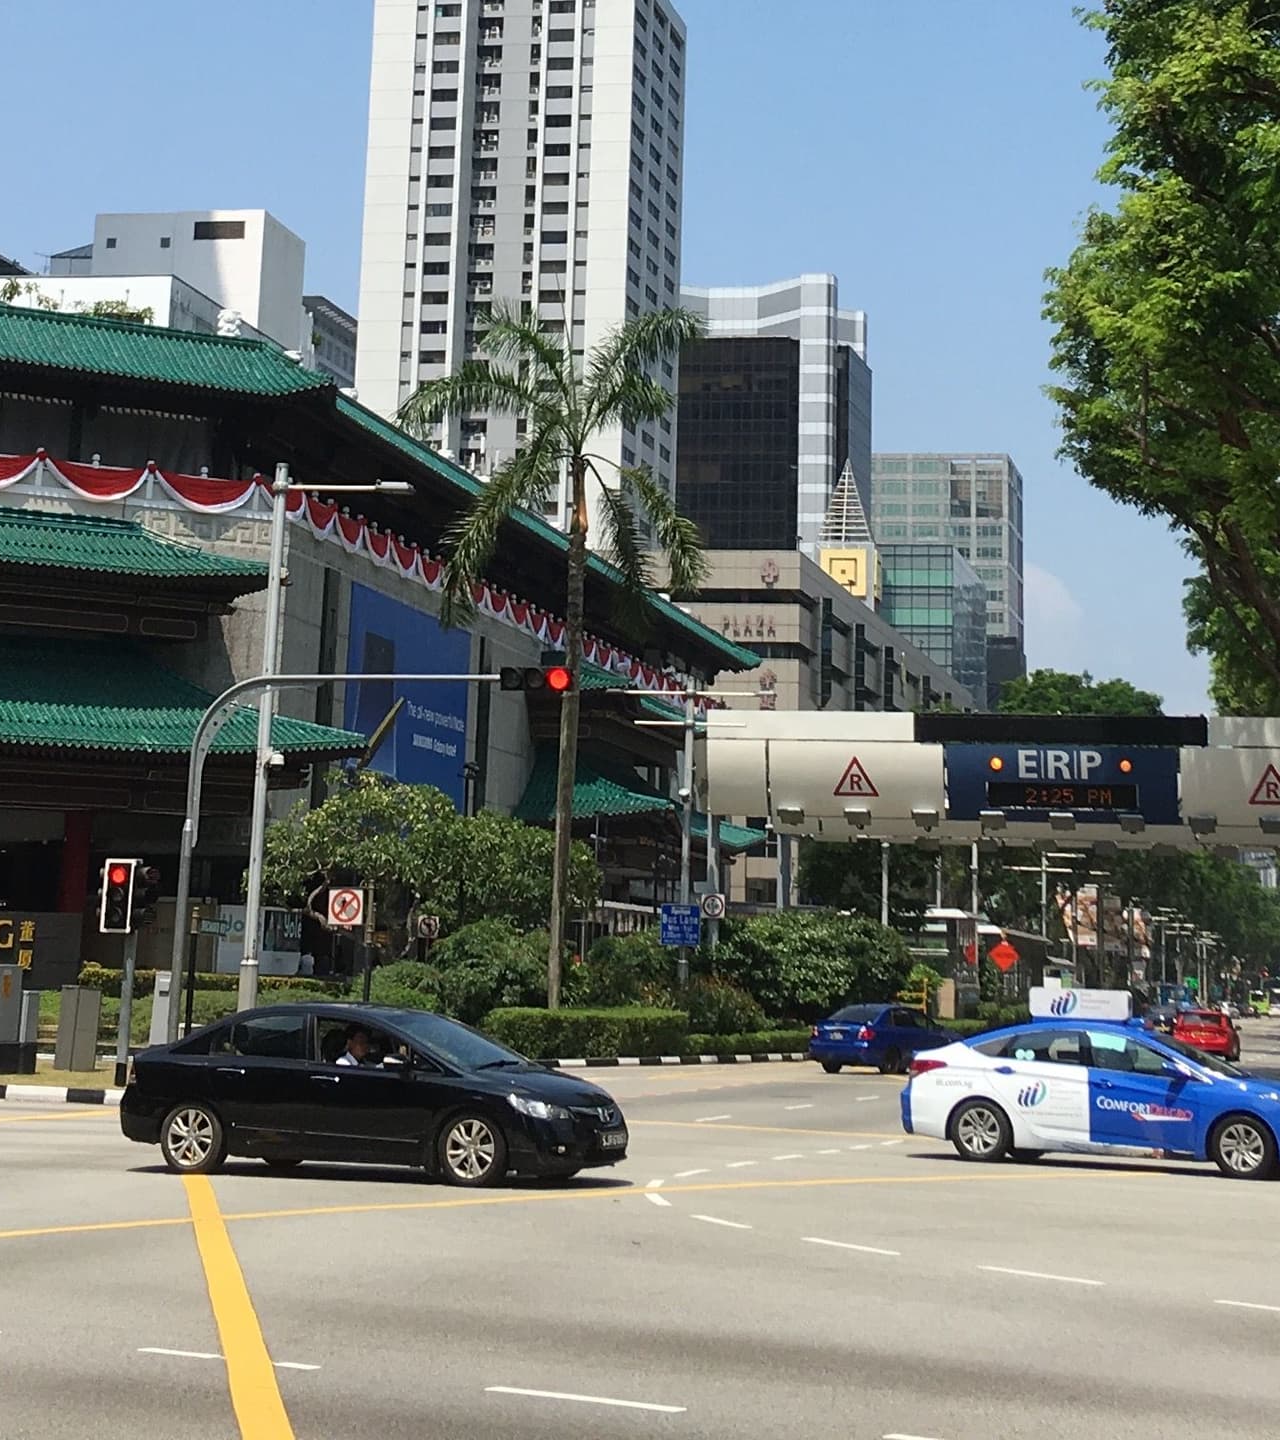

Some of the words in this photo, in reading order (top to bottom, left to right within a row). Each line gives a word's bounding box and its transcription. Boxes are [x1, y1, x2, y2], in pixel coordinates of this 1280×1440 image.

[850, 773, 863, 792] R
[1266, 781, 1280, 800] R
[1025, 787, 1075, 805] 2:25
[1086, 788, 1113, 806] PM
